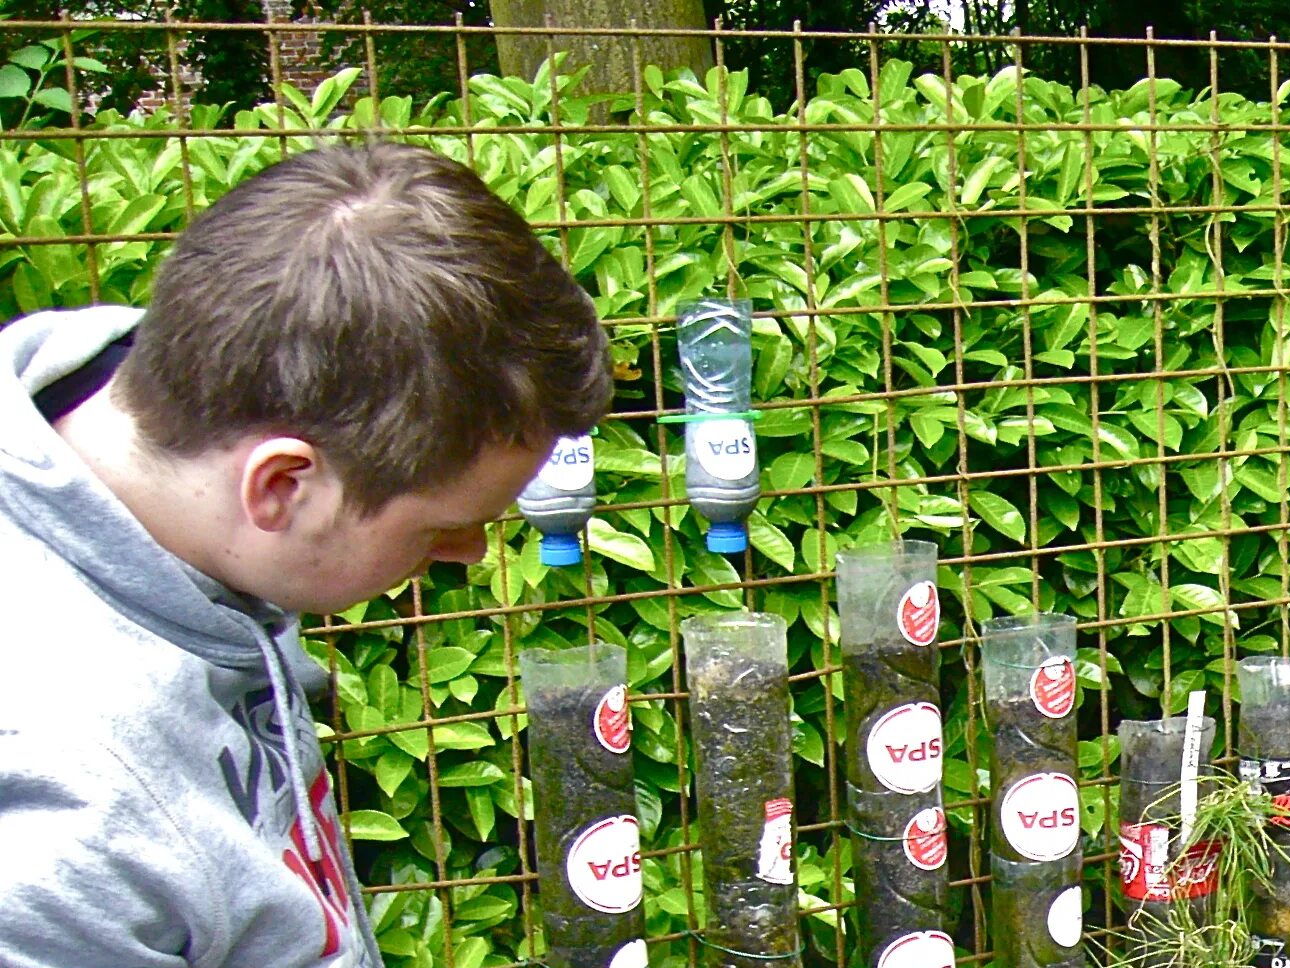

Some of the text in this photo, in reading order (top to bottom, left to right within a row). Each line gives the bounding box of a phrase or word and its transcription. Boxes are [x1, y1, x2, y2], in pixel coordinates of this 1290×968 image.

[551, 447, 590, 465] SPA
[708, 438, 750, 455] SPA
[885, 738, 941, 763] SPA
[1017, 807, 1075, 829] SPA
[587, 851, 641, 880] SPA
